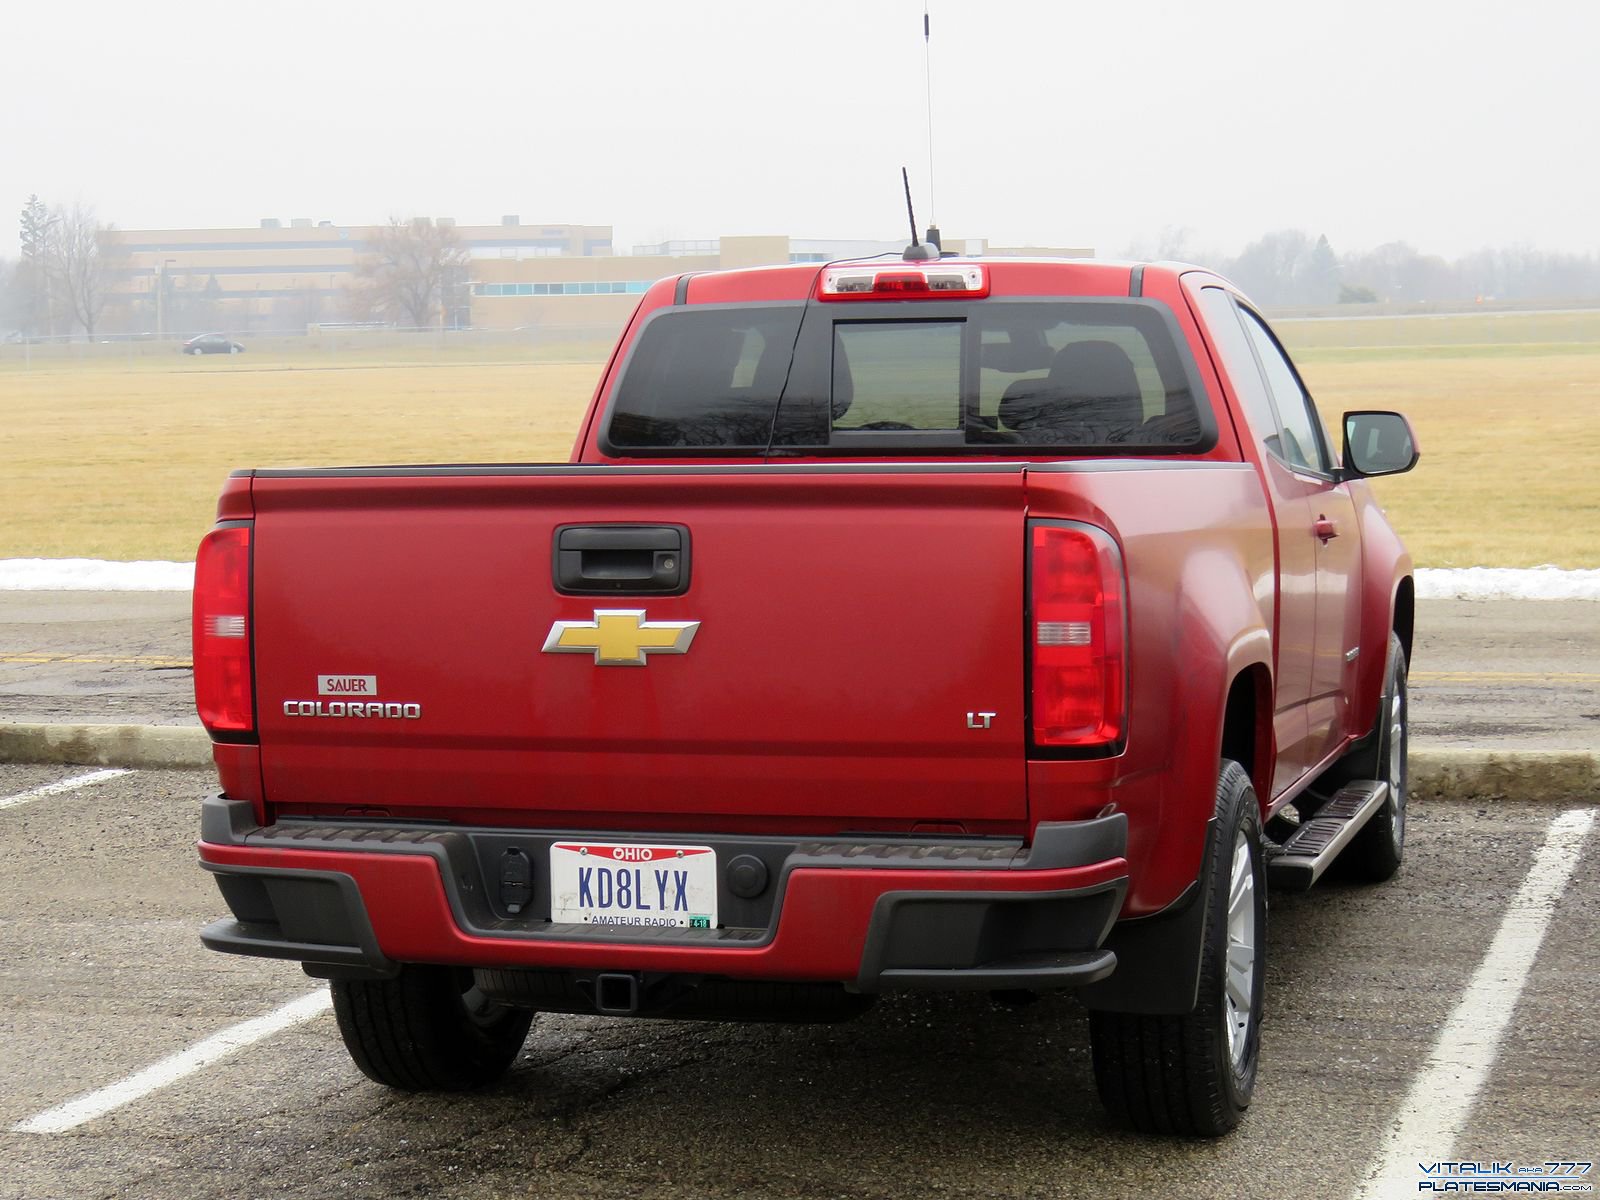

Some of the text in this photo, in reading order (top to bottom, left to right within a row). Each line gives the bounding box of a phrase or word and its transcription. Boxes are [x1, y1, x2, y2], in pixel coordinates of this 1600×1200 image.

[327, 678, 368, 692] SAUER
[283, 701, 421, 719] COLORADO
[966, 712, 997, 729] LT
[612, 847, 653, 861] OHIO
[578, 867, 689, 912] KD8LYX
[591, 916, 677, 928] AMATEUR RADIO
